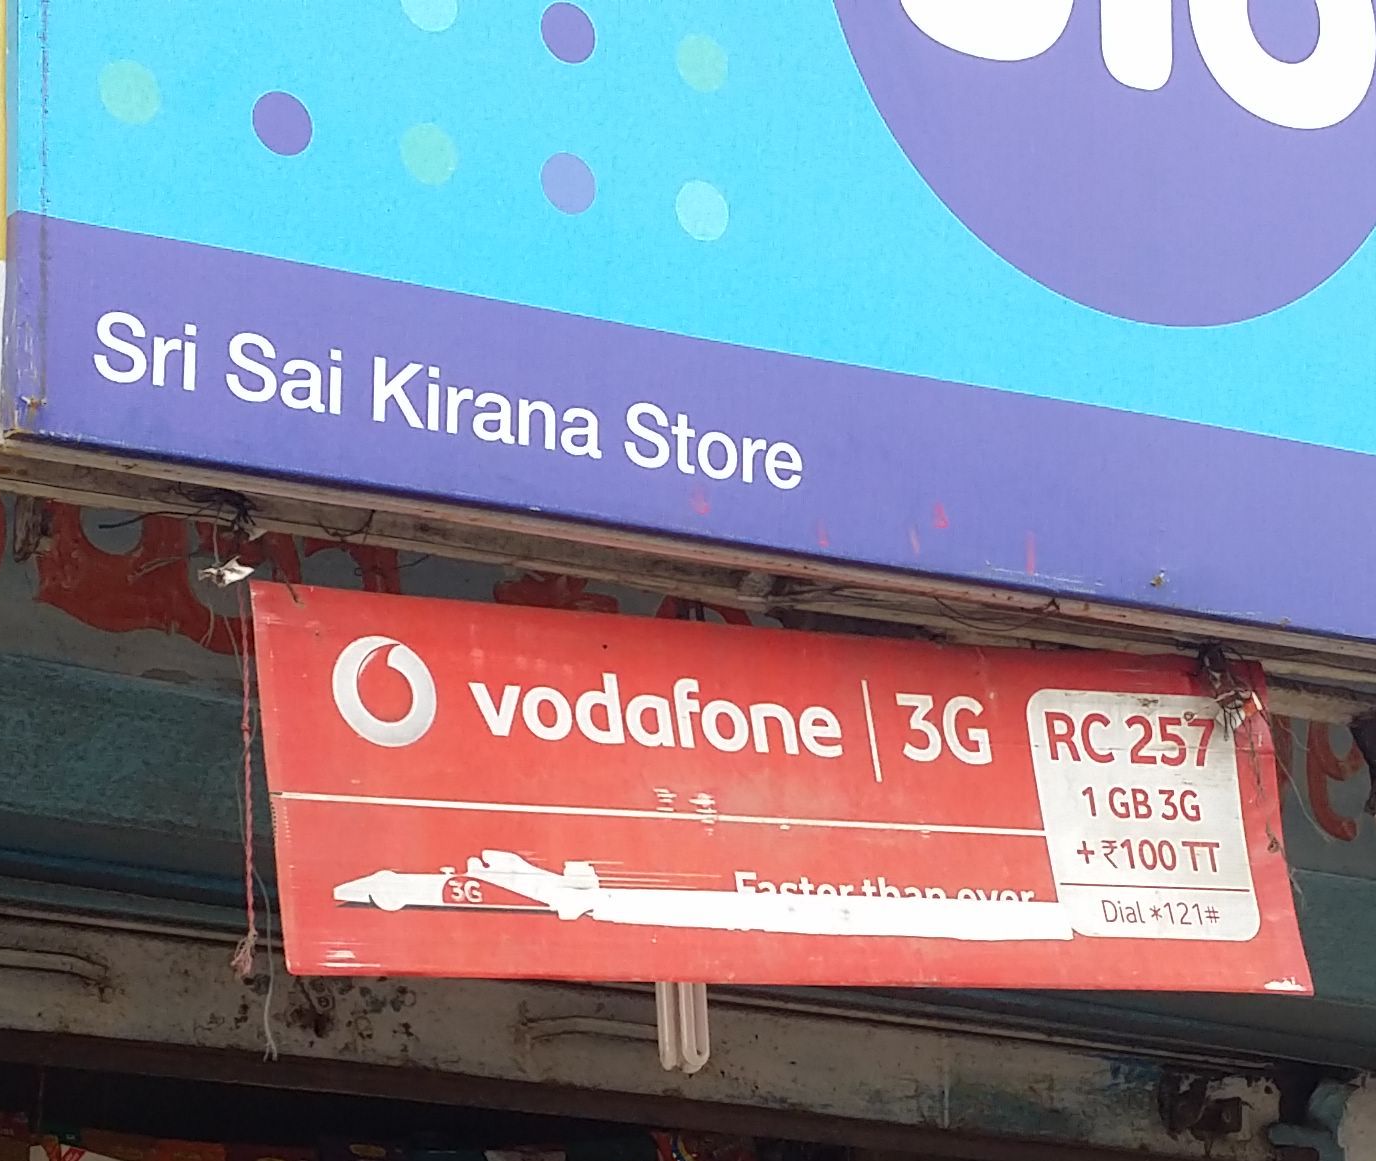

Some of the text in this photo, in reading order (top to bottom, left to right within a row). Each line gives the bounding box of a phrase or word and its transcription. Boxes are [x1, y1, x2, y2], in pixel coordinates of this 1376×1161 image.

[93, 311, 805, 491] Sri Sai Kirana Store
[468, 673, 994, 765] vodafone 3G
[1042, 711, 1216, 768] RC 257
[1082, 786, 1202, 822] 1 GB 3G
[1181, 841, 1221, 874] TT
[449, 881, 483, 904] 3G
[1102, 900, 1146, 925] Dial
